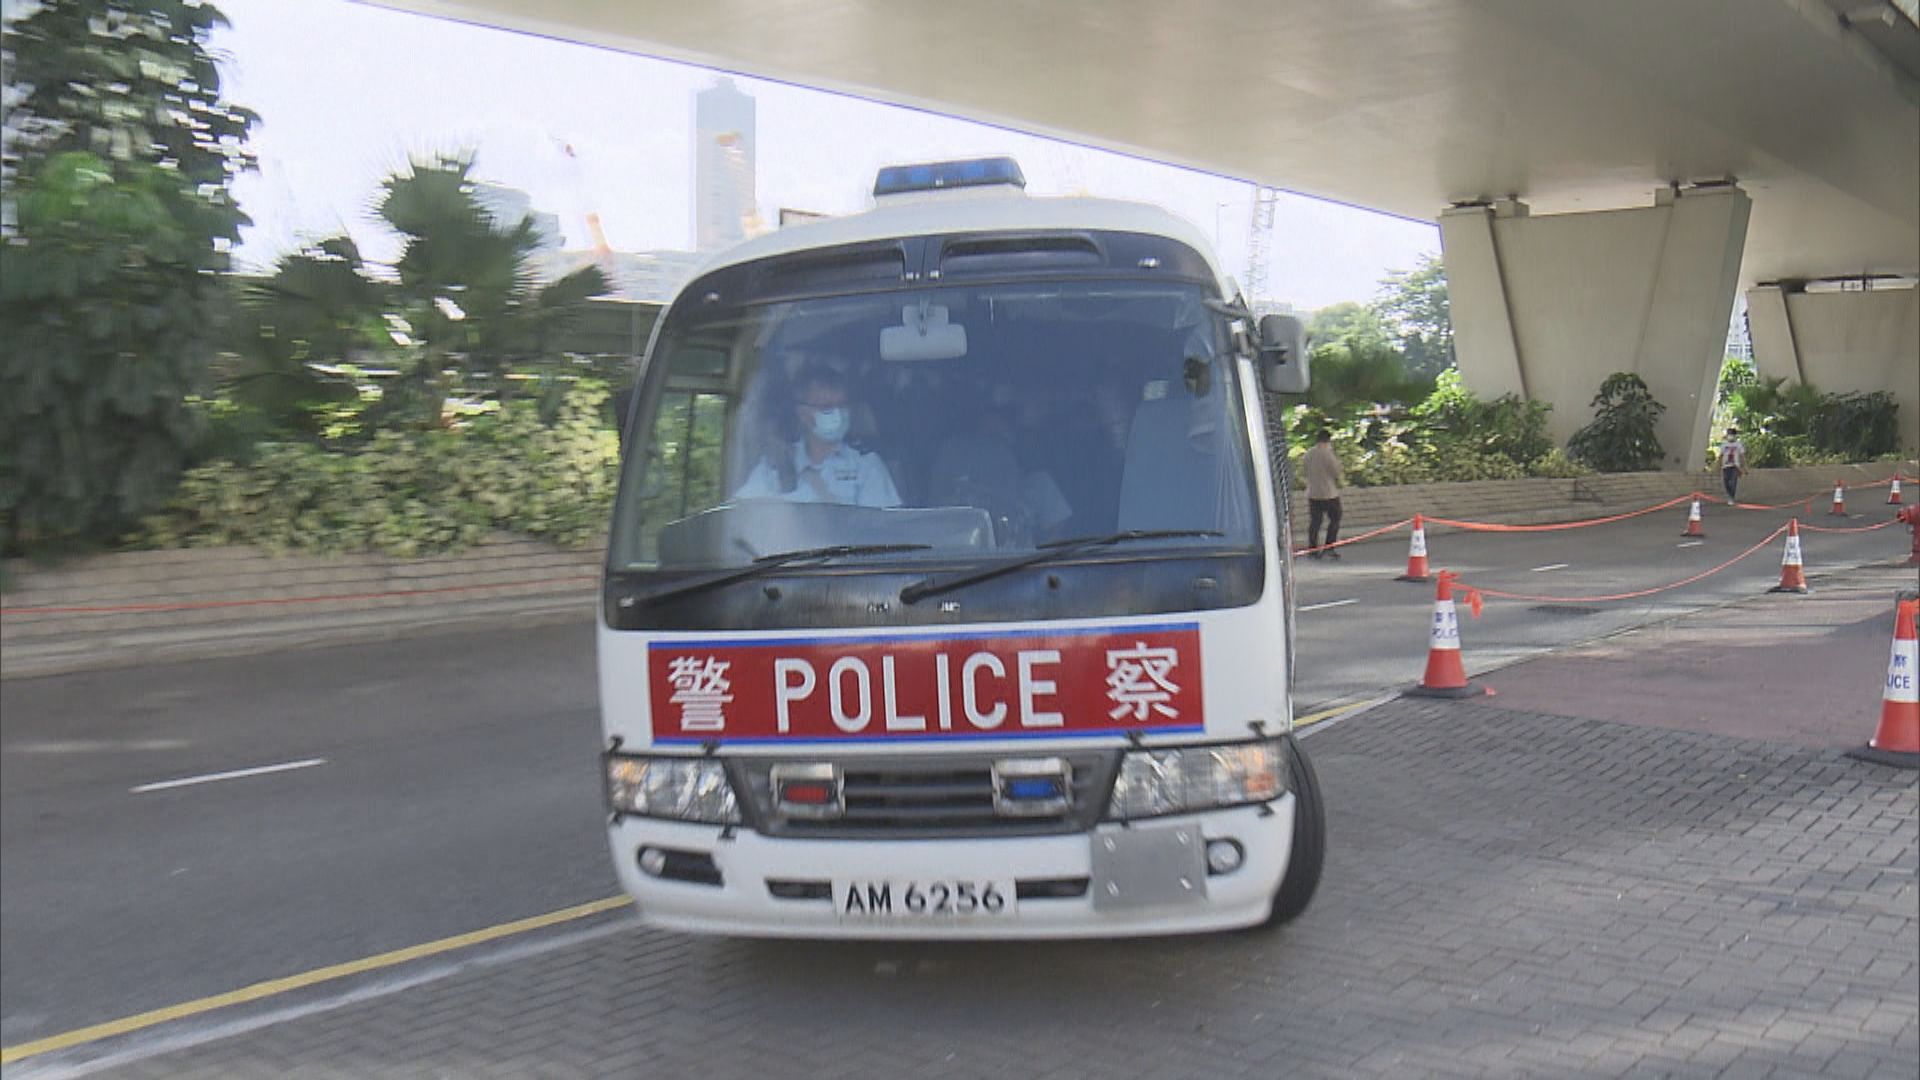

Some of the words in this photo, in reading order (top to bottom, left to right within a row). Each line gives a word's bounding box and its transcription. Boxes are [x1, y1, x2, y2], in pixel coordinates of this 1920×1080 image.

[667, 655, 735, 732] 警
[774, 649, 1065, 734] POLICE
[1105, 641, 1181, 721] 察
[845, 881, 892, 913] AM
[904, 881, 1005, 914] 6256
